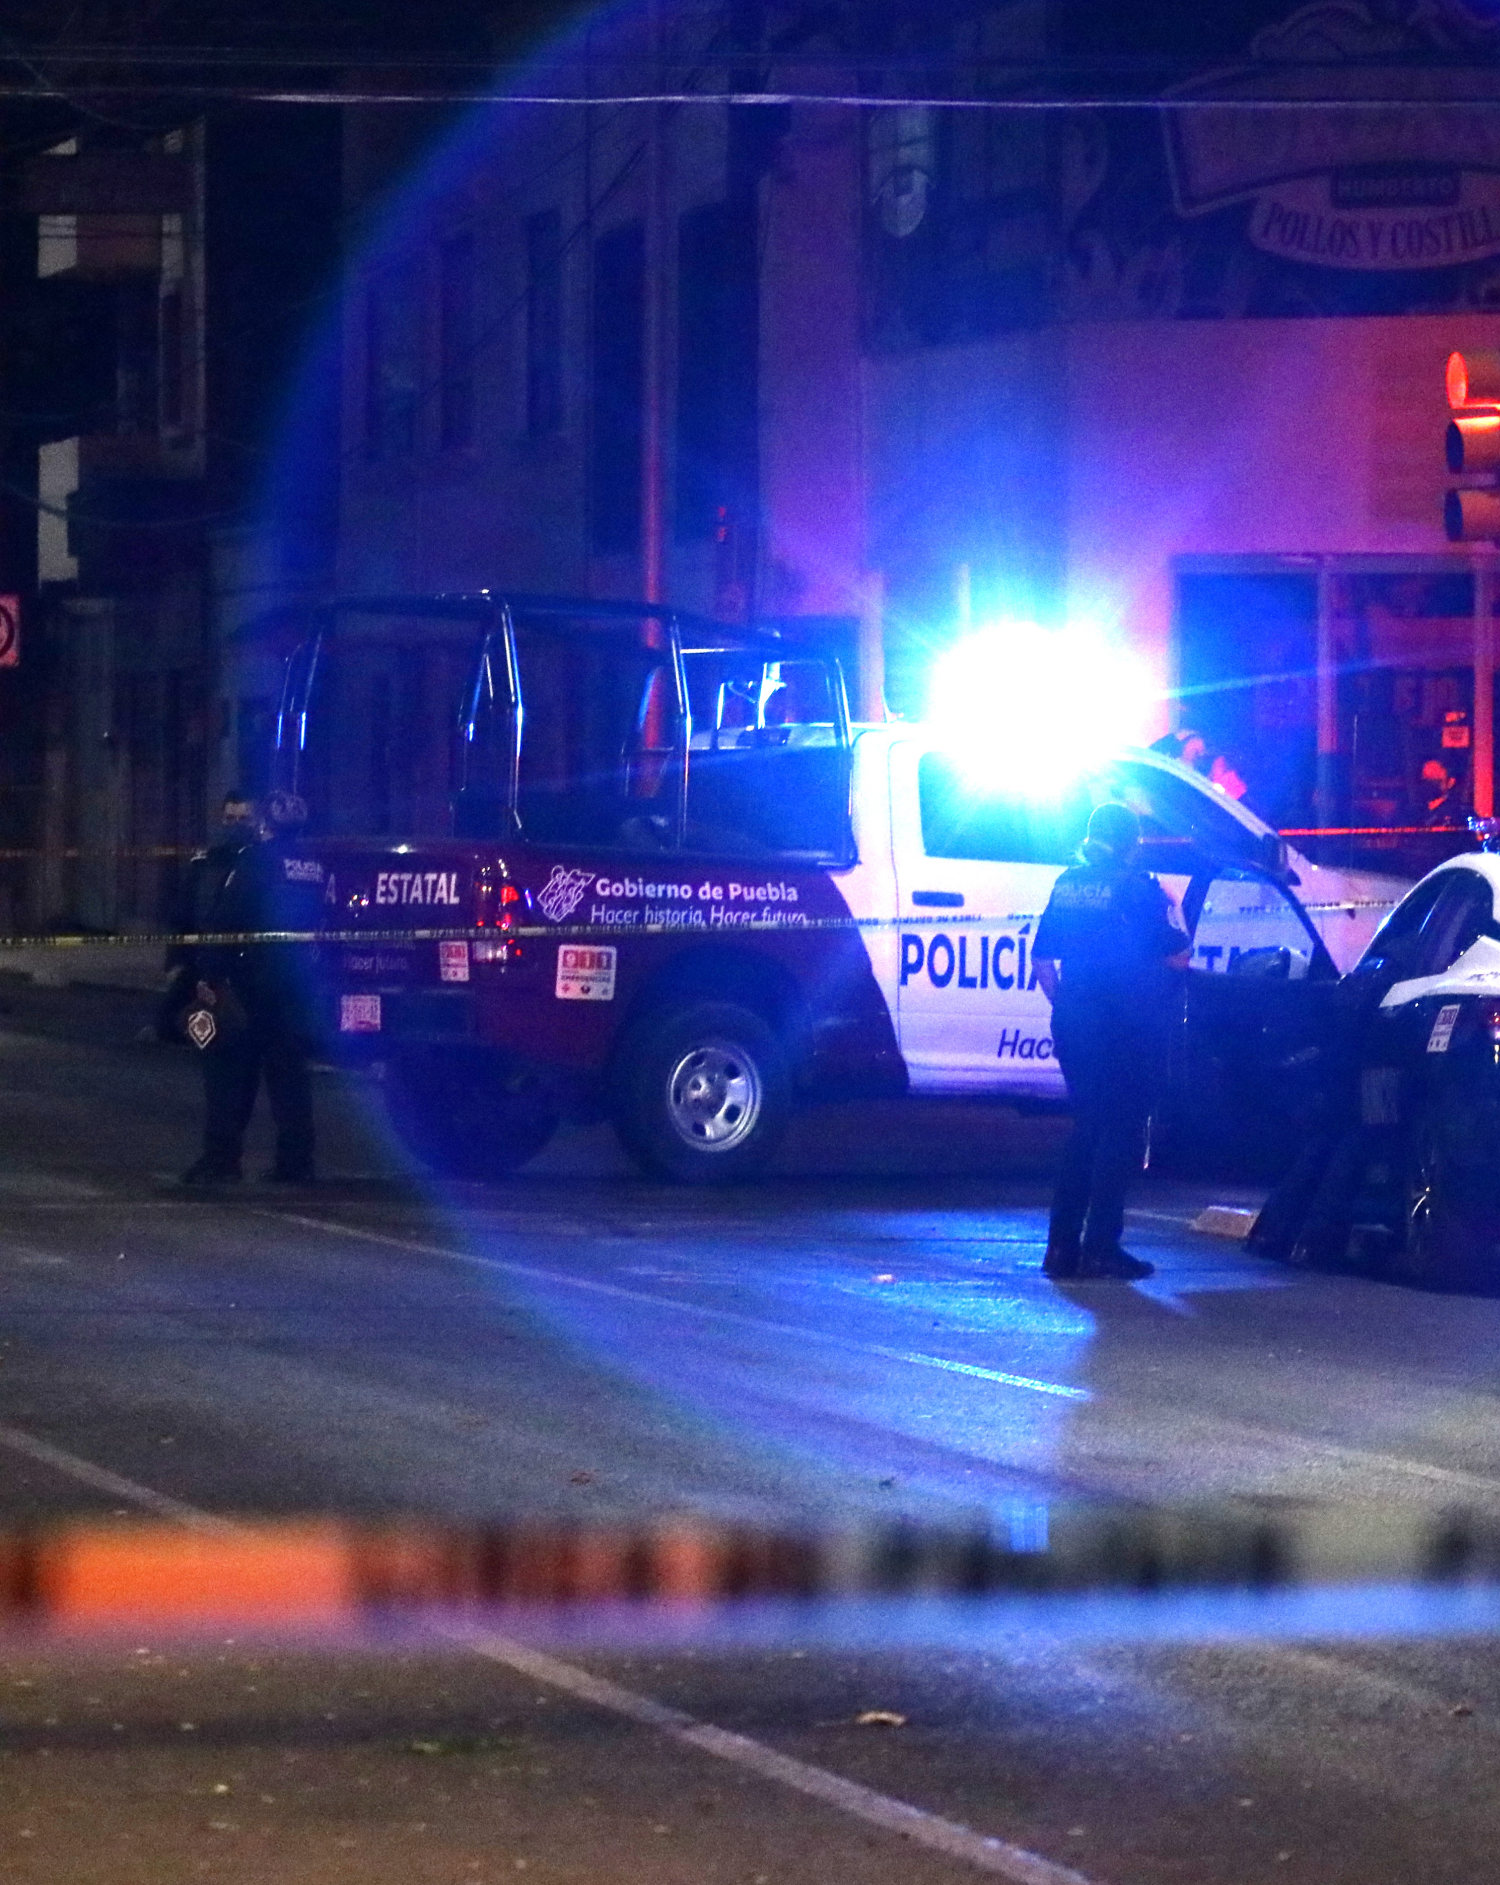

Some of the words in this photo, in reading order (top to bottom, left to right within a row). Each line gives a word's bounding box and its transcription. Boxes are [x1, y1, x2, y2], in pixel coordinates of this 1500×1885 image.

[1262, 202, 1361, 259] POLLOS
[1366, 222, 1383, 258] Y
[375, 872, 460, 904] ESTATAL
[595, 878, 693, 899] Gobierno
[698, 881, 723, 900] de
[729, 882, 799, 901] Puebla
[591, 904, 640, 924] Hacer
[710, 905, 757, 925] Hacer
[565, 952, 608, 969] 911
[900, 920, 1043, 990] POLICÍ
